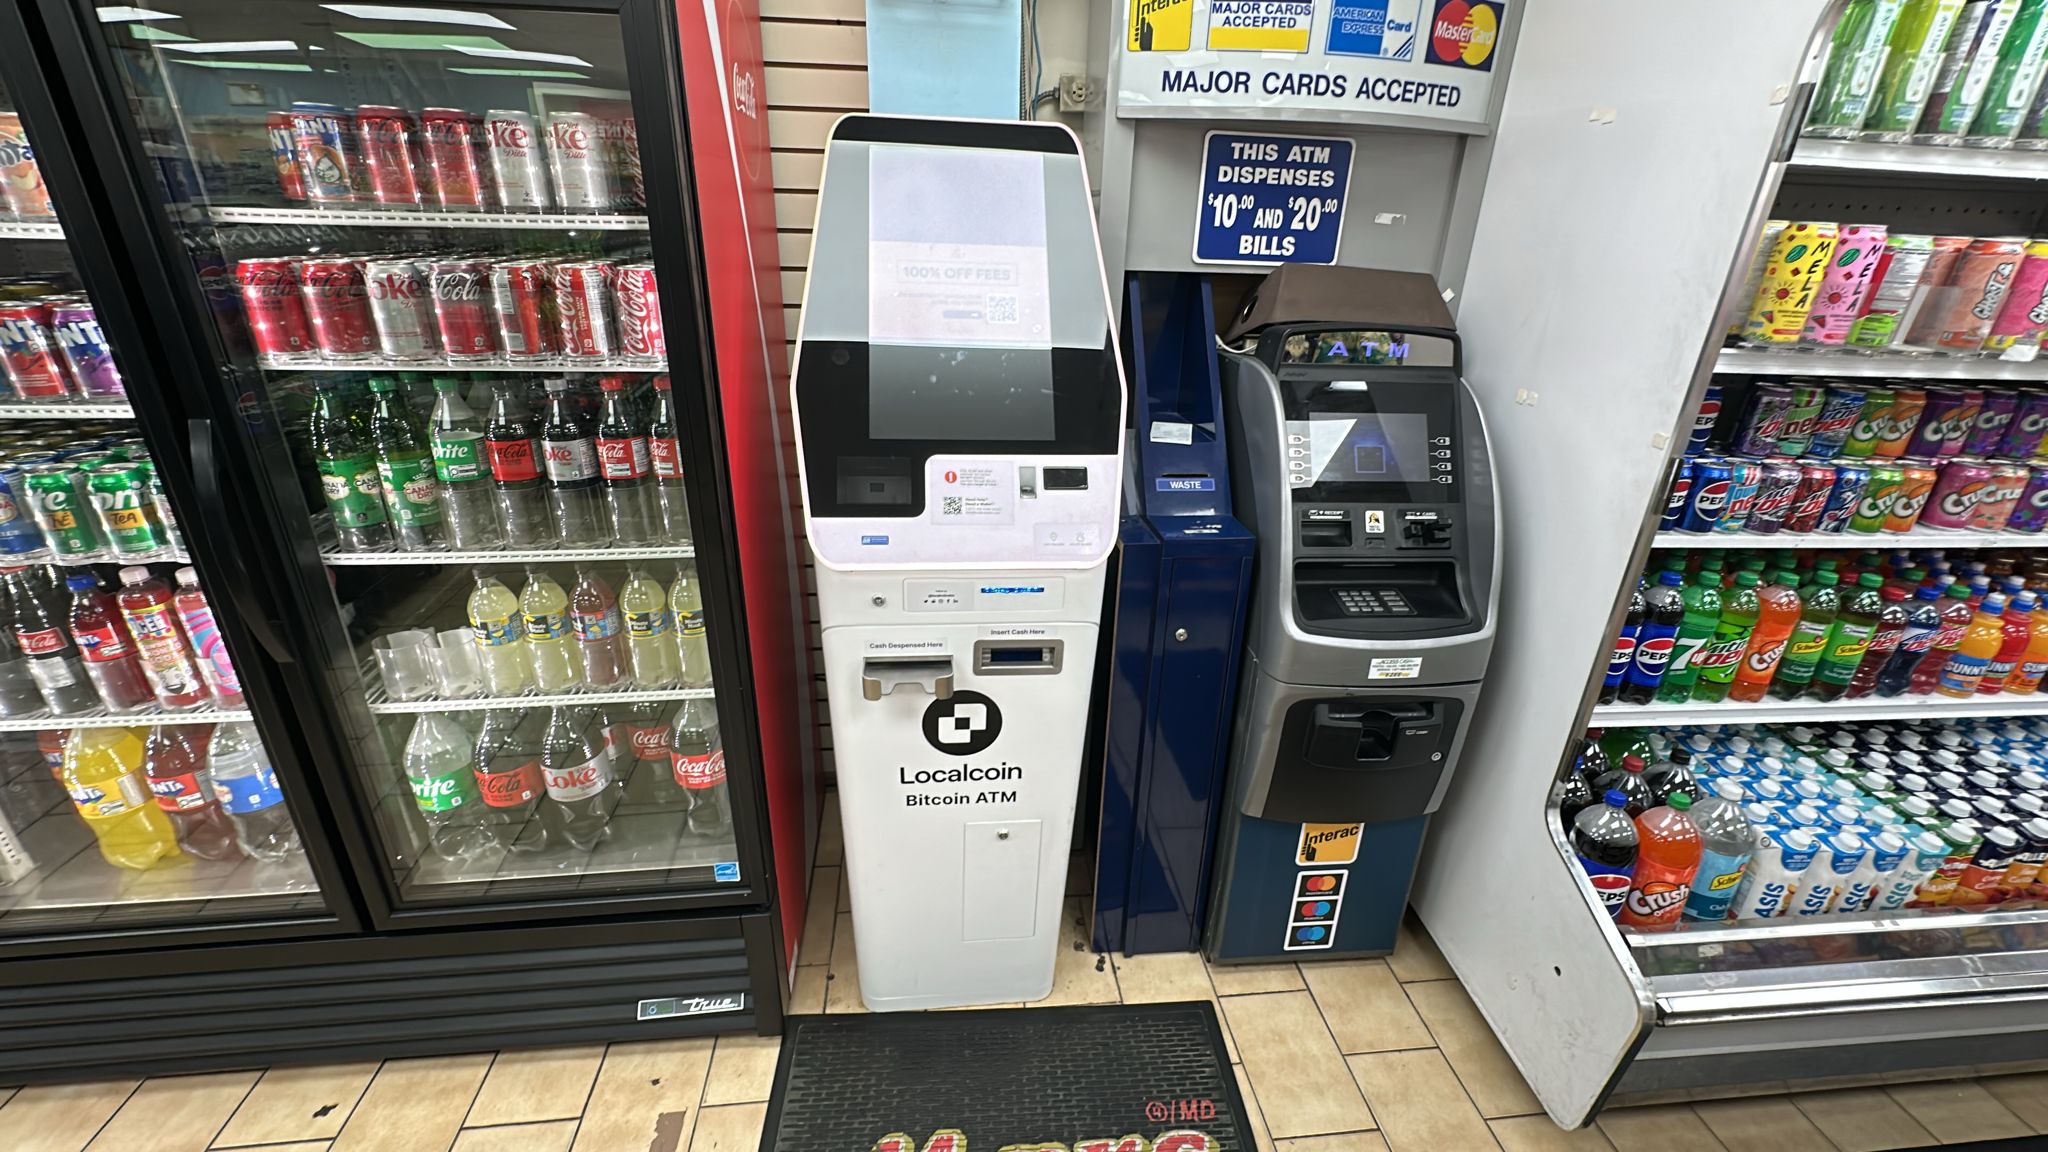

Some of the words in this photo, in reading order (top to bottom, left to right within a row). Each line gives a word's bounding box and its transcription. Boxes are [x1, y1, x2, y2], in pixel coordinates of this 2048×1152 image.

[1211, 3, 1260, 15] MAJOR
[1264, 4, 1312, 16] CARDS
[1333, 6, 1384, 22] AMERICAN
[1222, 16, 1297, 28] ACCEPTED
[1341, 21, 1385, 36] EXPRESS
[1386, 19, 1412, 33] Card
[1435, 20, 1494, 45] MasterCard
[1161, 70, 1250, 94] MAJOR
[1262, 72, 1347, 98] CARDS
[1356, 77, 1461, 107] ACCEPTED
[1231, 142, 1279, 162] THIS
[1286, 145, 1331, 164] ATM
[1217, 166, 1335, 188] DISPENSES
[1208, 192, 1254, 229] $10.00
[1253, 208, 1284, 230] AND
[1288, 196, 1338, 232] $20.00
[1239, 234, 1296, 257] BILLS
[903, 266, 941, 279] 100%
[944, 267, 973, 280] OFF
[976, 268, 1012, 281] FEES
[1794, 241, 1831, 309] MELA
[1845, 244, 1883, 312] MELA
[1328, 341, 1410, 359] ATM
[1169, 481, 1202, 490] WASTE
[991, 628, 1012, 636] Insert
[1013, 628, 1028, 636] Cash
[1029, 628, 1046, 636] Here
[869, 642, 887, 650] Cash
[929, 641, 944, 649] Here
[899, 761, 1023, 785] Localcoin
[906, 791, 970, 807] Bitcoin
[975, 790, 1018, 804] ATM
[1303, 825, 1360, 847] Interac
[1628, 880, 1691, 917] Crush
[682, 997, 734, 1012] true
